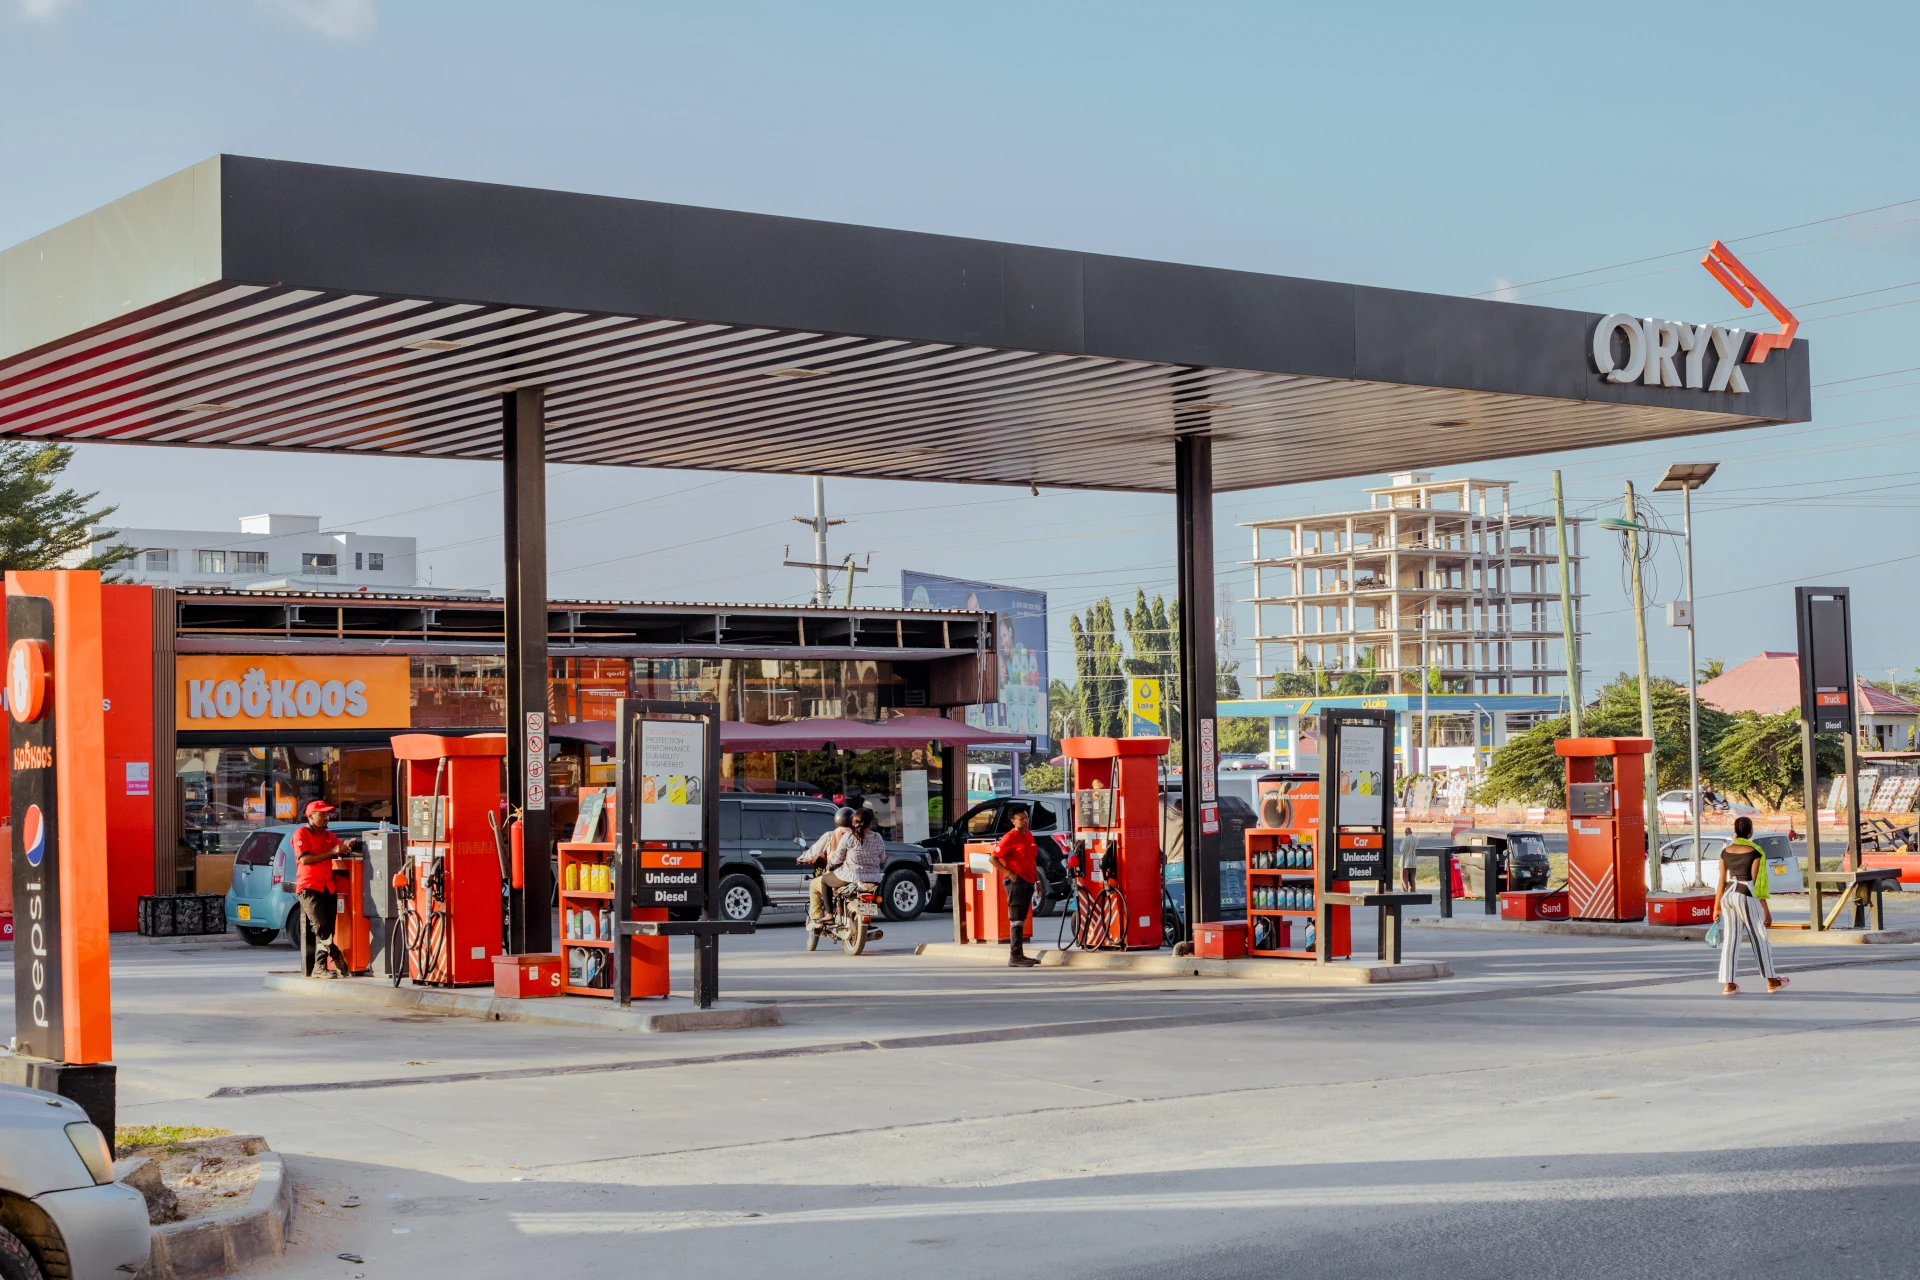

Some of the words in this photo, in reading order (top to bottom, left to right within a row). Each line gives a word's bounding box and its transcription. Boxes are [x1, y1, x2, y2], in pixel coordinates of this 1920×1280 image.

[1593, 312, 1750, 393] ORYX
[187, 668, 367, 718] KOOKOOS
[1368, 698, 1388, 709] Lake
[1823, 695, 1841, 704] Truck
[1825, 720, 1842, 729] Diesel
[645, 736, 684, 745] PROTECTION
[645, 744, 691, 753] PERFORMANCE
[13, 740, 53, 771] KOOKOOS
[645, 752, 681, 761] DURABILITY
[645, 760, 684, 769] ENGINEERED
[1353, 836, 1369, 847] Car
[661, 853, 683, 866] Car
[1342, 852, 1380, 862] Unleaded
[1348, 866, 1372, 877] Diesel
[645, 872, 698, 884] Unleaded
[654, 890, 688, 902] Diesel
[1541, 903, 1562, 914] Sand
[1691, 907, 1711, 917] Sand
[26, 882, 49, 1028] pepsi
